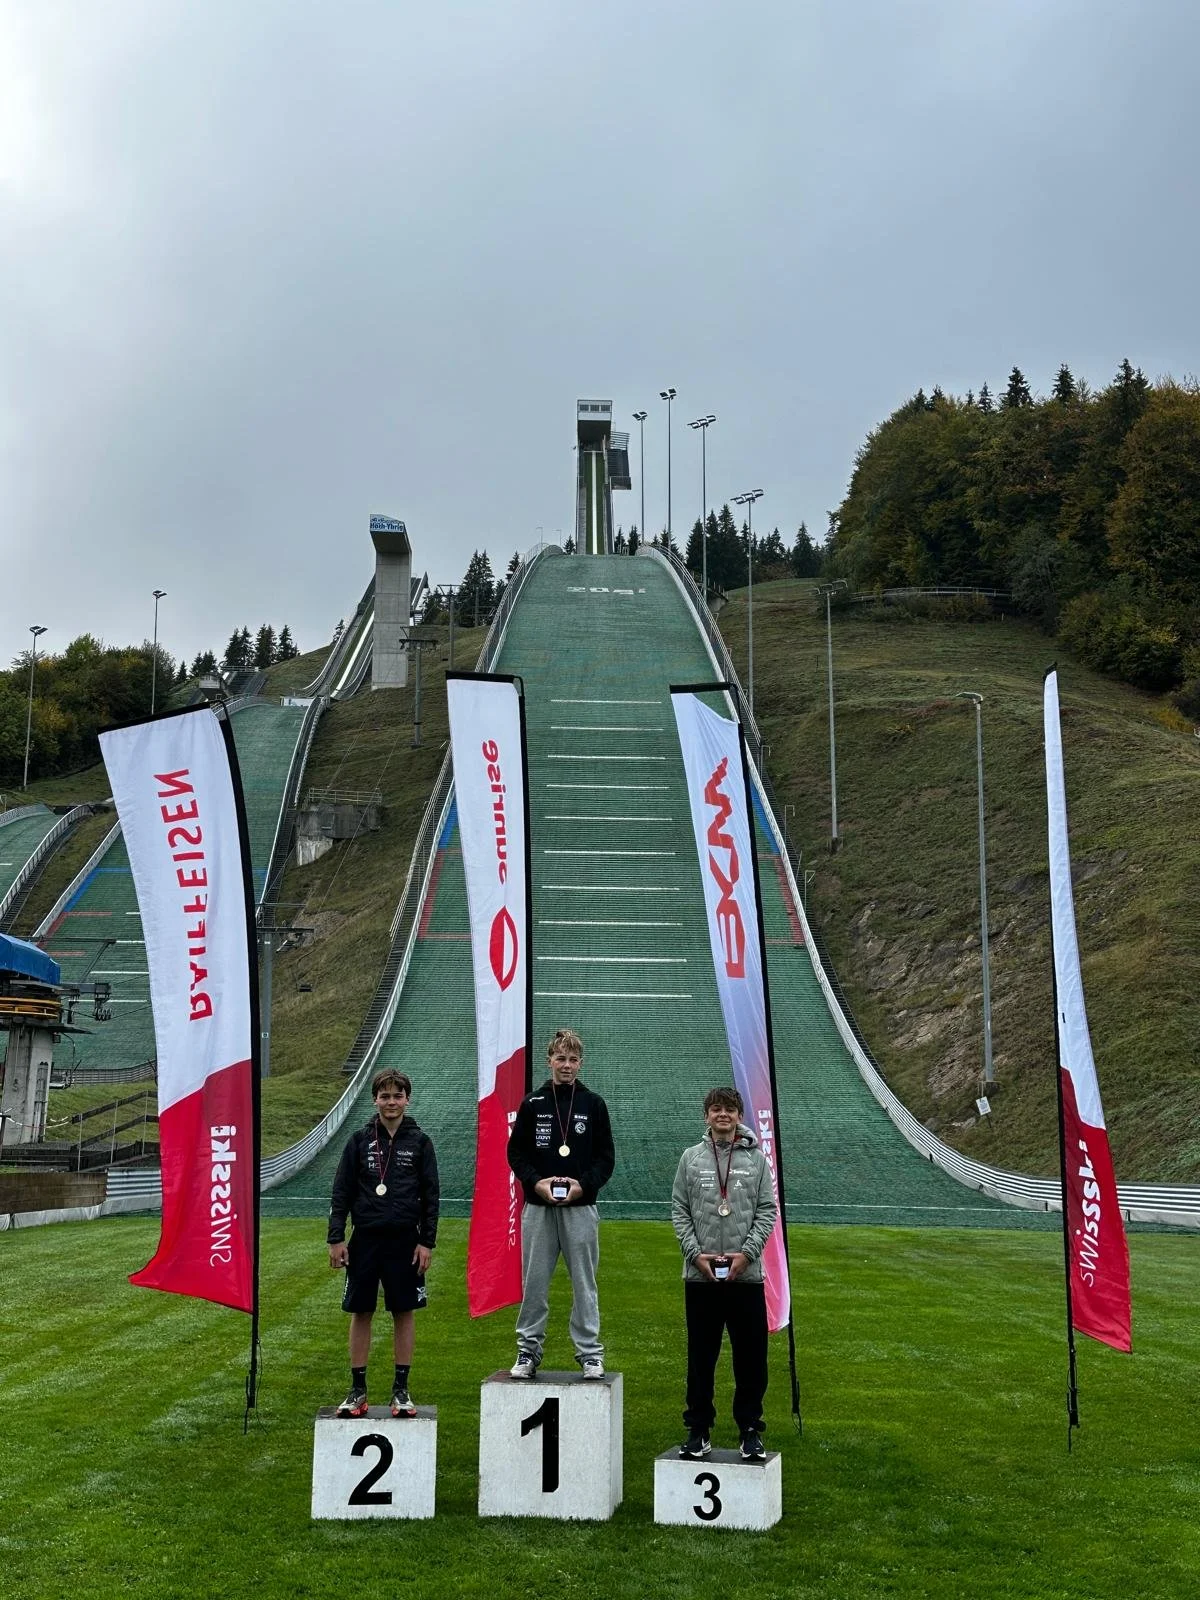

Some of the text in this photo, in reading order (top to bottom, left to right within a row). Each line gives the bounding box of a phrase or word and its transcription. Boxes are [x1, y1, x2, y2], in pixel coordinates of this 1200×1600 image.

[348, 1433, 395, 1505] 2
[521, 1397, 560, 1493] 1
[693, 1471, 722, 1521] 3
